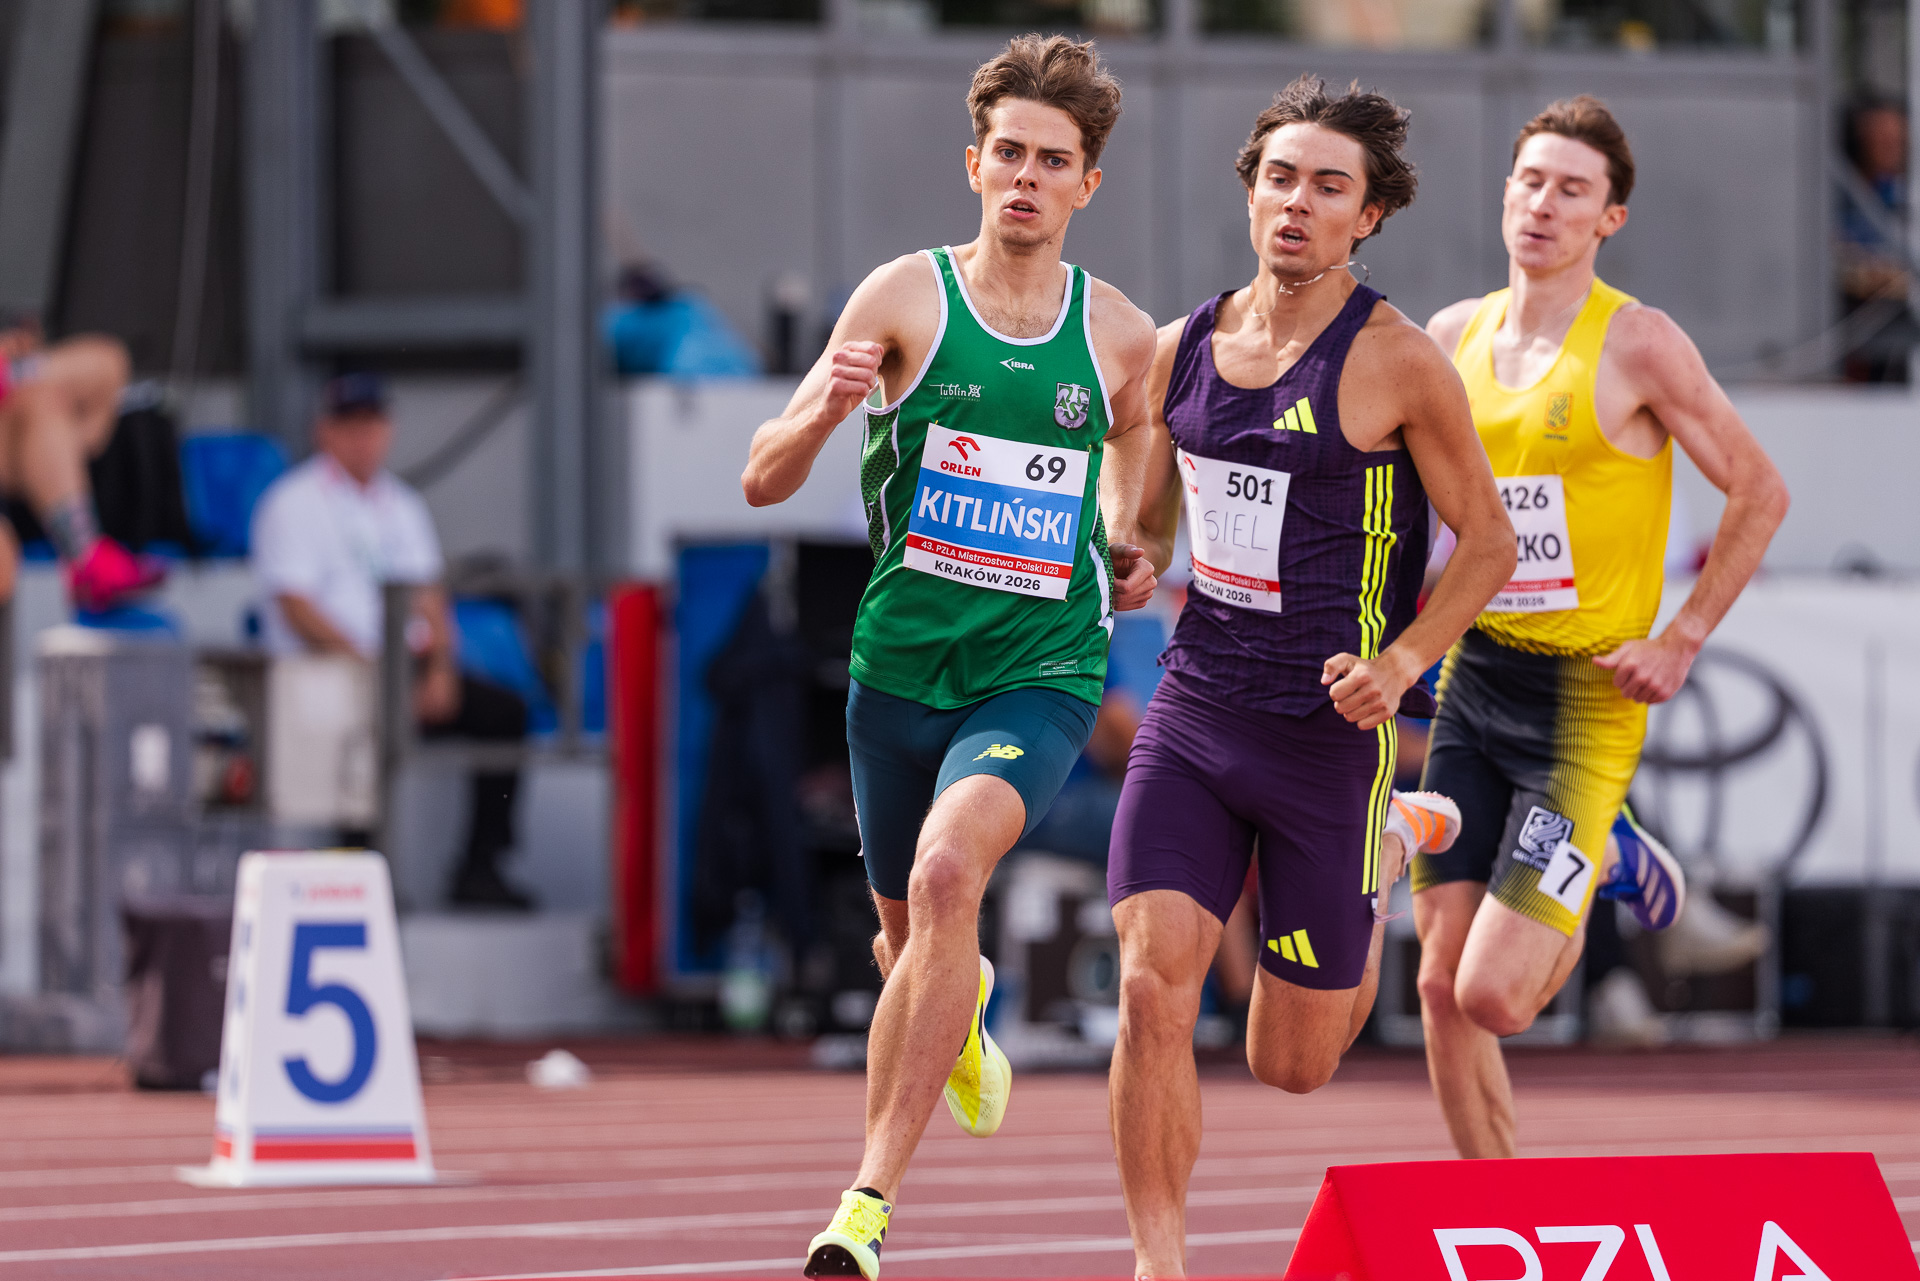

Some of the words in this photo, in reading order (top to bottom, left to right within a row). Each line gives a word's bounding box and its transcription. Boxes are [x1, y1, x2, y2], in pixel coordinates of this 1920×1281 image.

[940, 460, 982, 477] ORLEN
[1025, 454, 1067, 483] 69
[1226, 471, 1273, 505] 501
[917, 485, 1073, 546] KITLIŃSKI
[1191, 506, 1269, 551] SIEL
[921, 540, 934, 552] 43.
[936, 544, 956, 558] PZLA
[958, 550, 1014, 568] Mistrzostwa
[1015, 559, 1043, 573] Polski
[1044, 564, 1059, 576] U23
[934, 560, 1002, 584] KRAKÓW
[1004, 575, 1041, 591] 2026
[1225, 589, 1253, 604] 2026
[1557, 851, 1586, 896] 7
[283, 924, 378, 1104] 5
